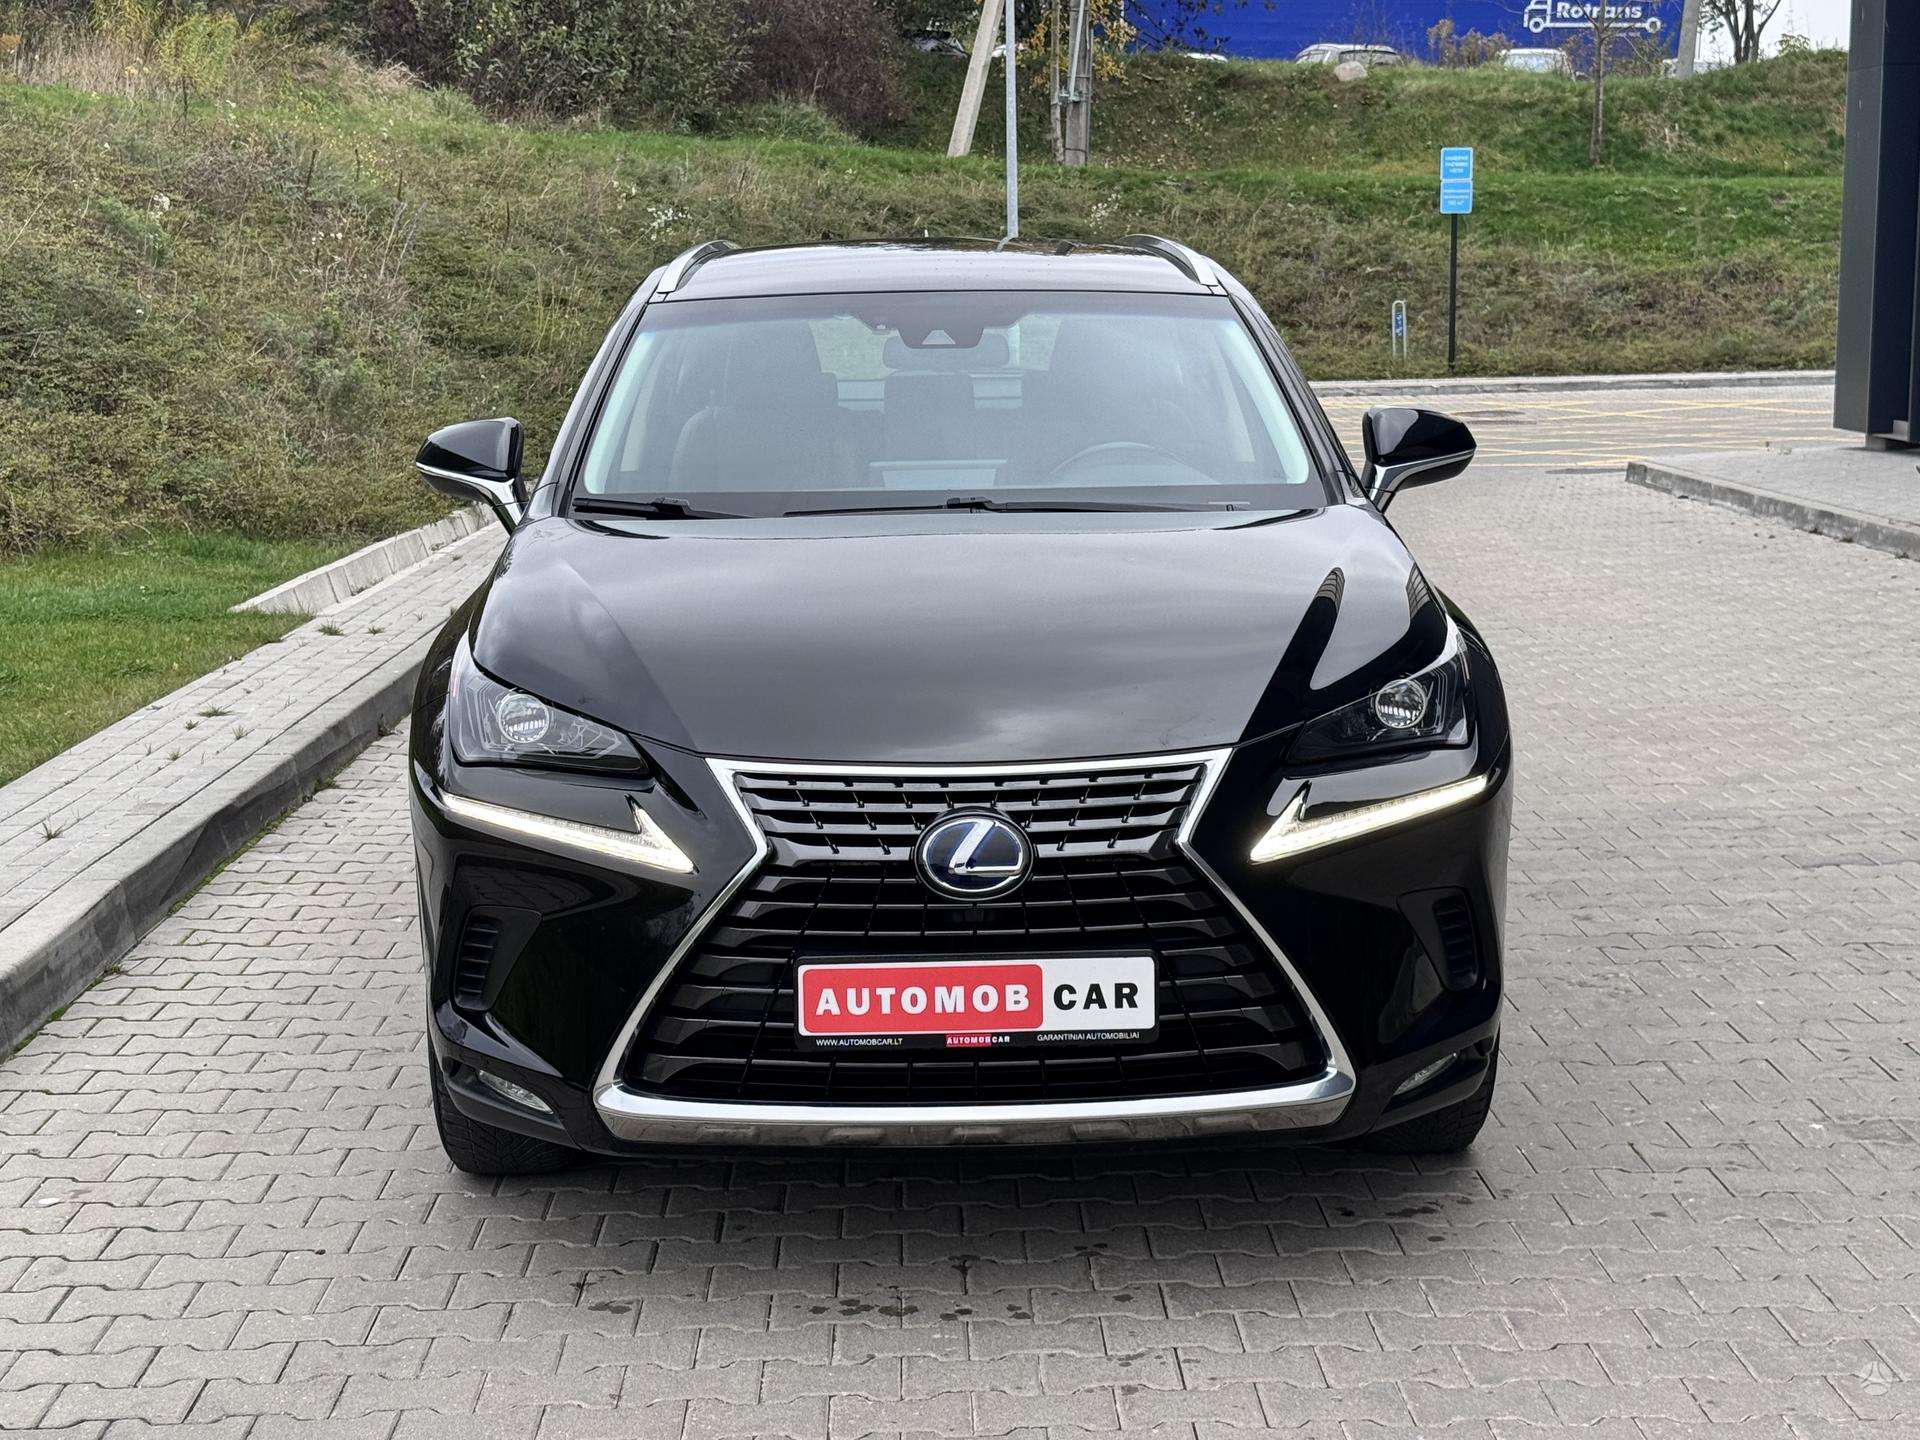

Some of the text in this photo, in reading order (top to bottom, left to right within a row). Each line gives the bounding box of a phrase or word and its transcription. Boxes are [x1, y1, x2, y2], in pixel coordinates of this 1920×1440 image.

[1556, 2, 1642, 19] Rotrans
[815, 982, 1139, 1016] AUTOMOB CAR
[815, 1037, 903, 1047] WWW.AUTOMOBCAR.LT
[1037, 1031, 1140, 1042] GARANTINIAI AUTOMOBILIAI
